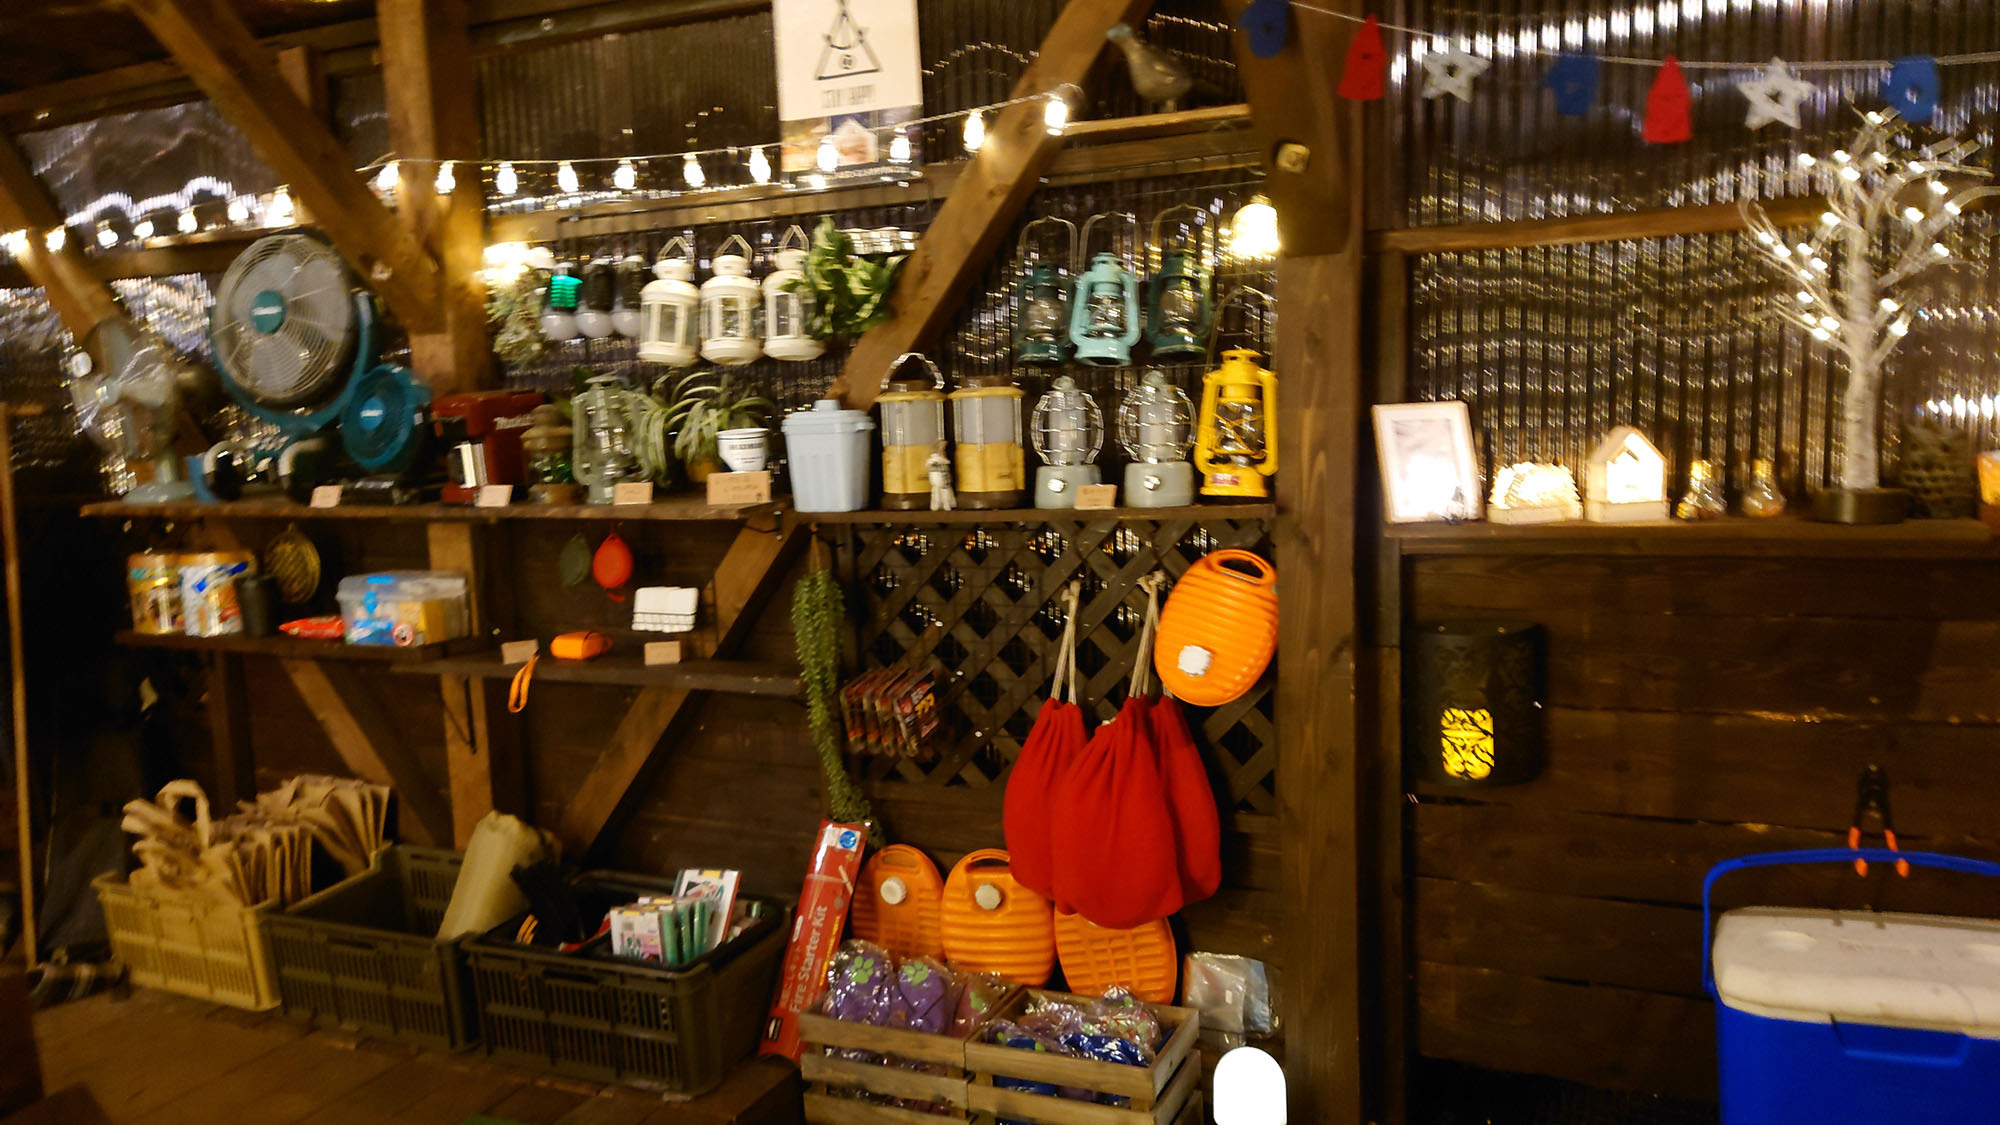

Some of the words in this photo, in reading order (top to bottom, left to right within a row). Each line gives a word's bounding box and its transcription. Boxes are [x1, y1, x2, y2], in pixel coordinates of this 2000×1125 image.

[789, 983, 806, 1012] Fire
[798, 928, 820, 980] Starter
[812, 906, 828, 926] Kit
